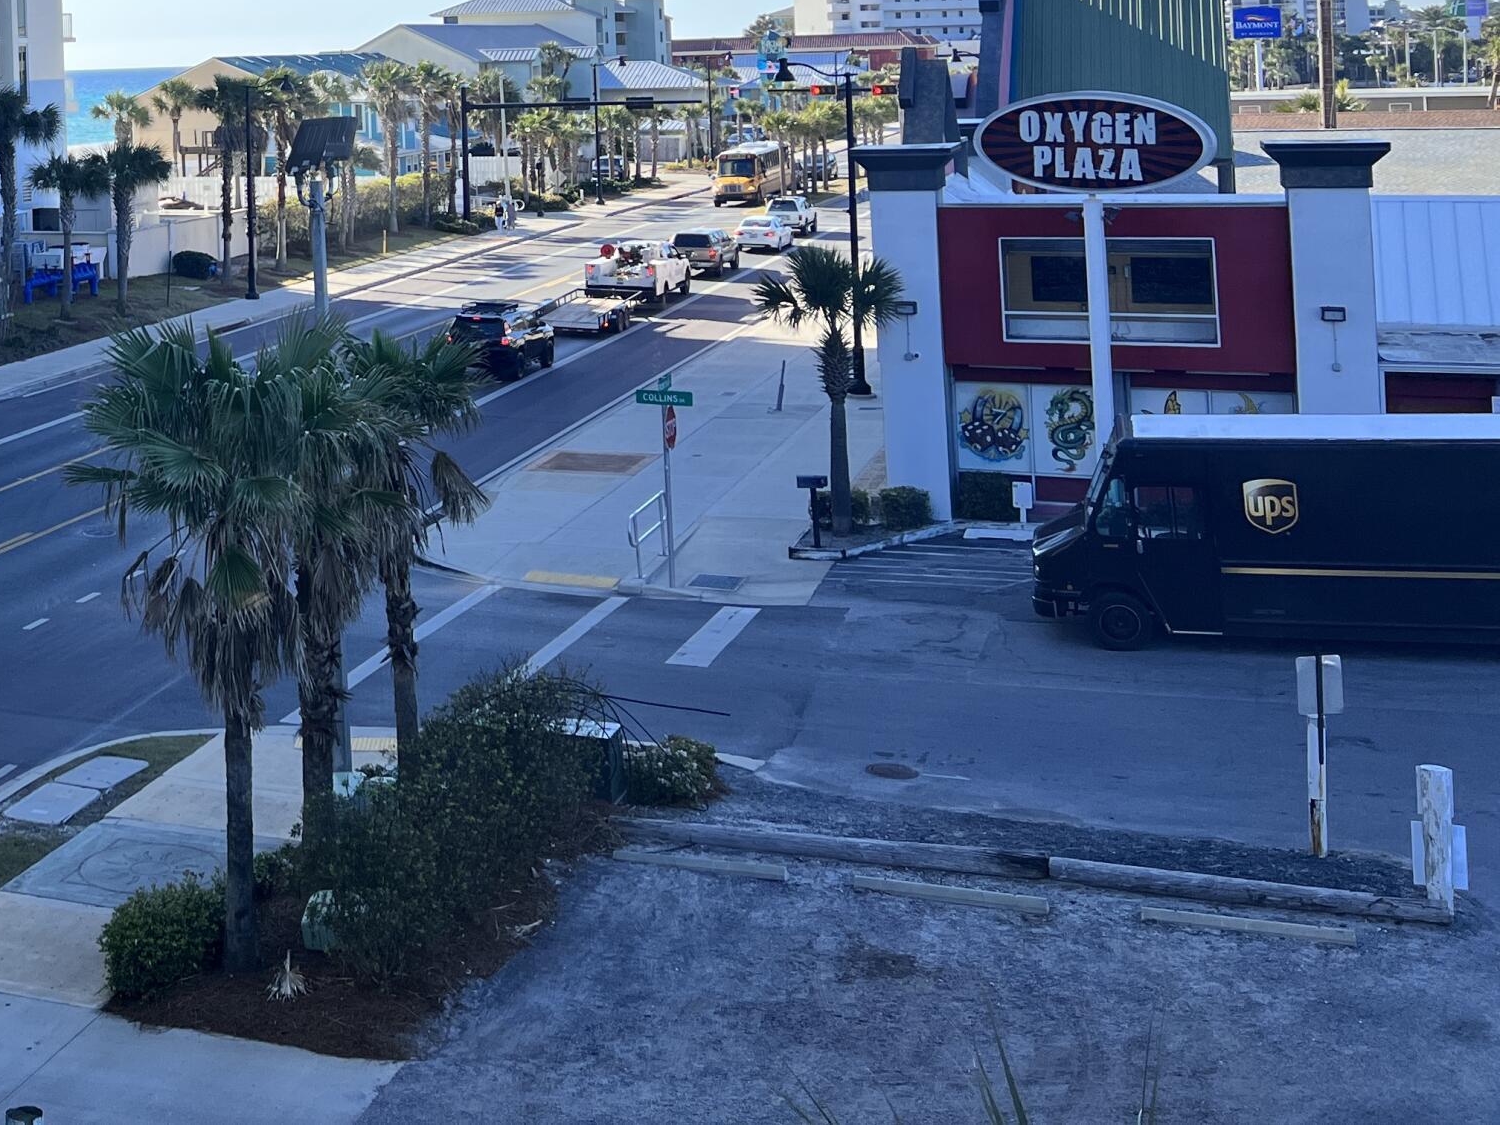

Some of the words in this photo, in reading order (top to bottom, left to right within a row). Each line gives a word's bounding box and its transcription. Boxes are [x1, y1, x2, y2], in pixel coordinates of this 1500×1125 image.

[1235, 21, 1279, 29] BAYMONT
[1018, 110, 1157, 145] OXYGEN
[1032, 145, 1144, 181] PLAZA
[642, 392, 678, 403] COLLINS
[1248, 495, 1295, 525] ups
